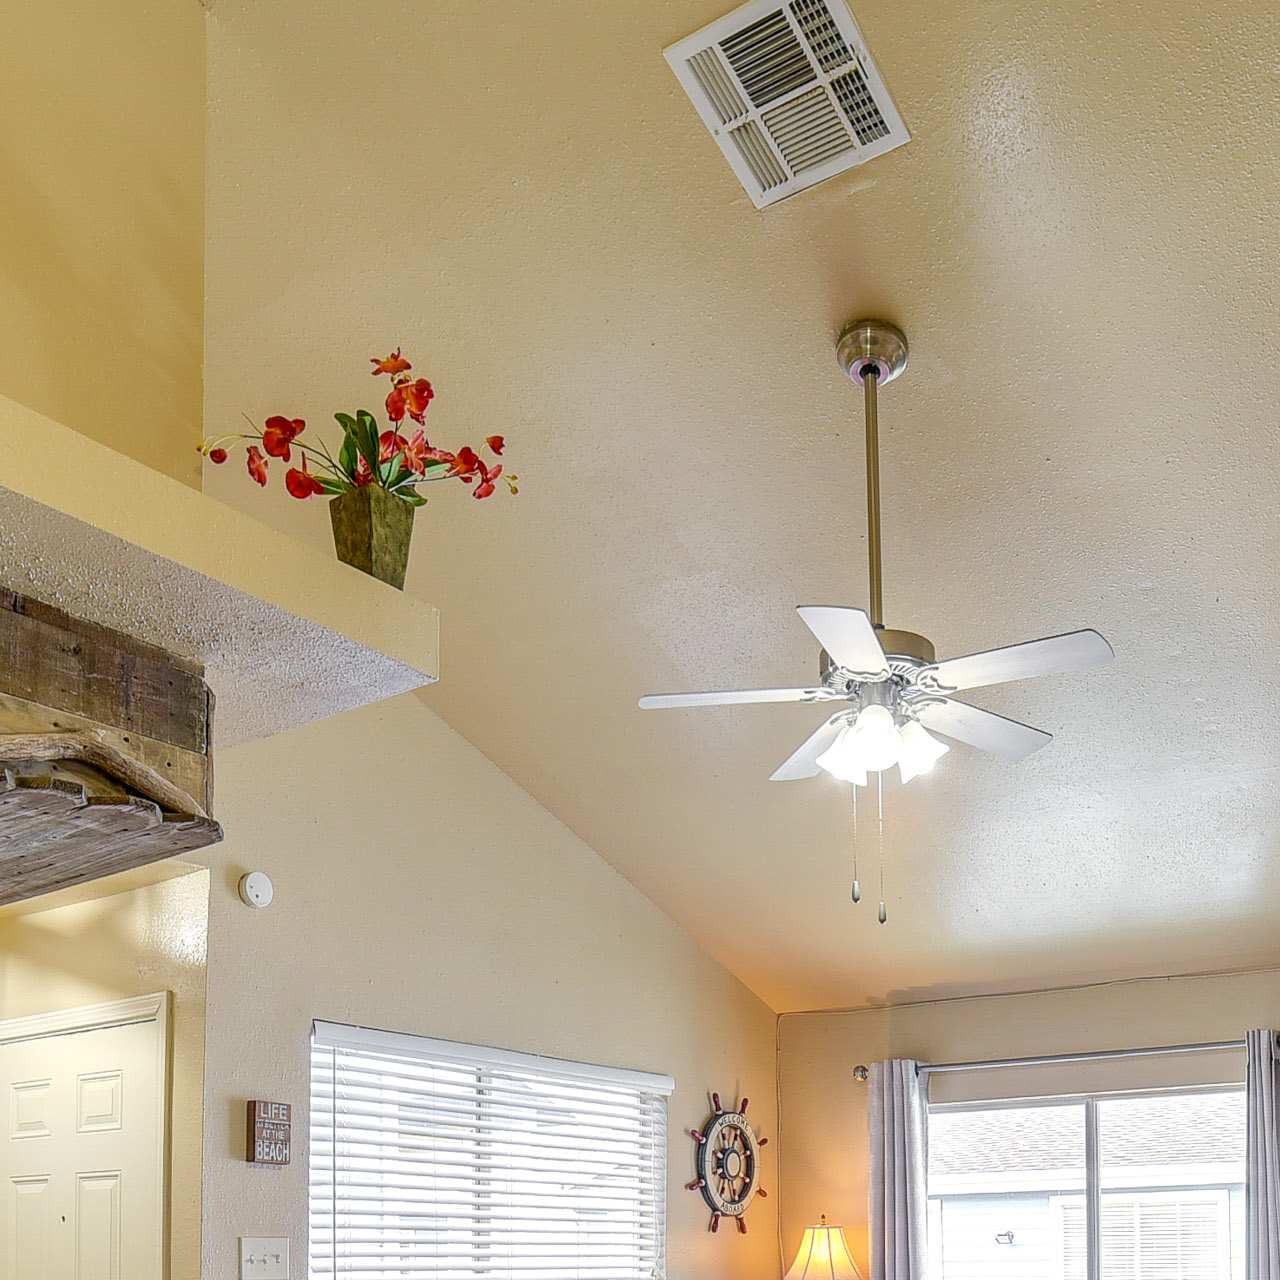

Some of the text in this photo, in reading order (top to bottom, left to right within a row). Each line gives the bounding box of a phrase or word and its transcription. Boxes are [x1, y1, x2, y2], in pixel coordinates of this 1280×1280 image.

[260, 1103, 287, 1120] LIFE
[719, 1115, 751, 1132] WELCOME
[256, 1141, 289, 1161] BEACH
